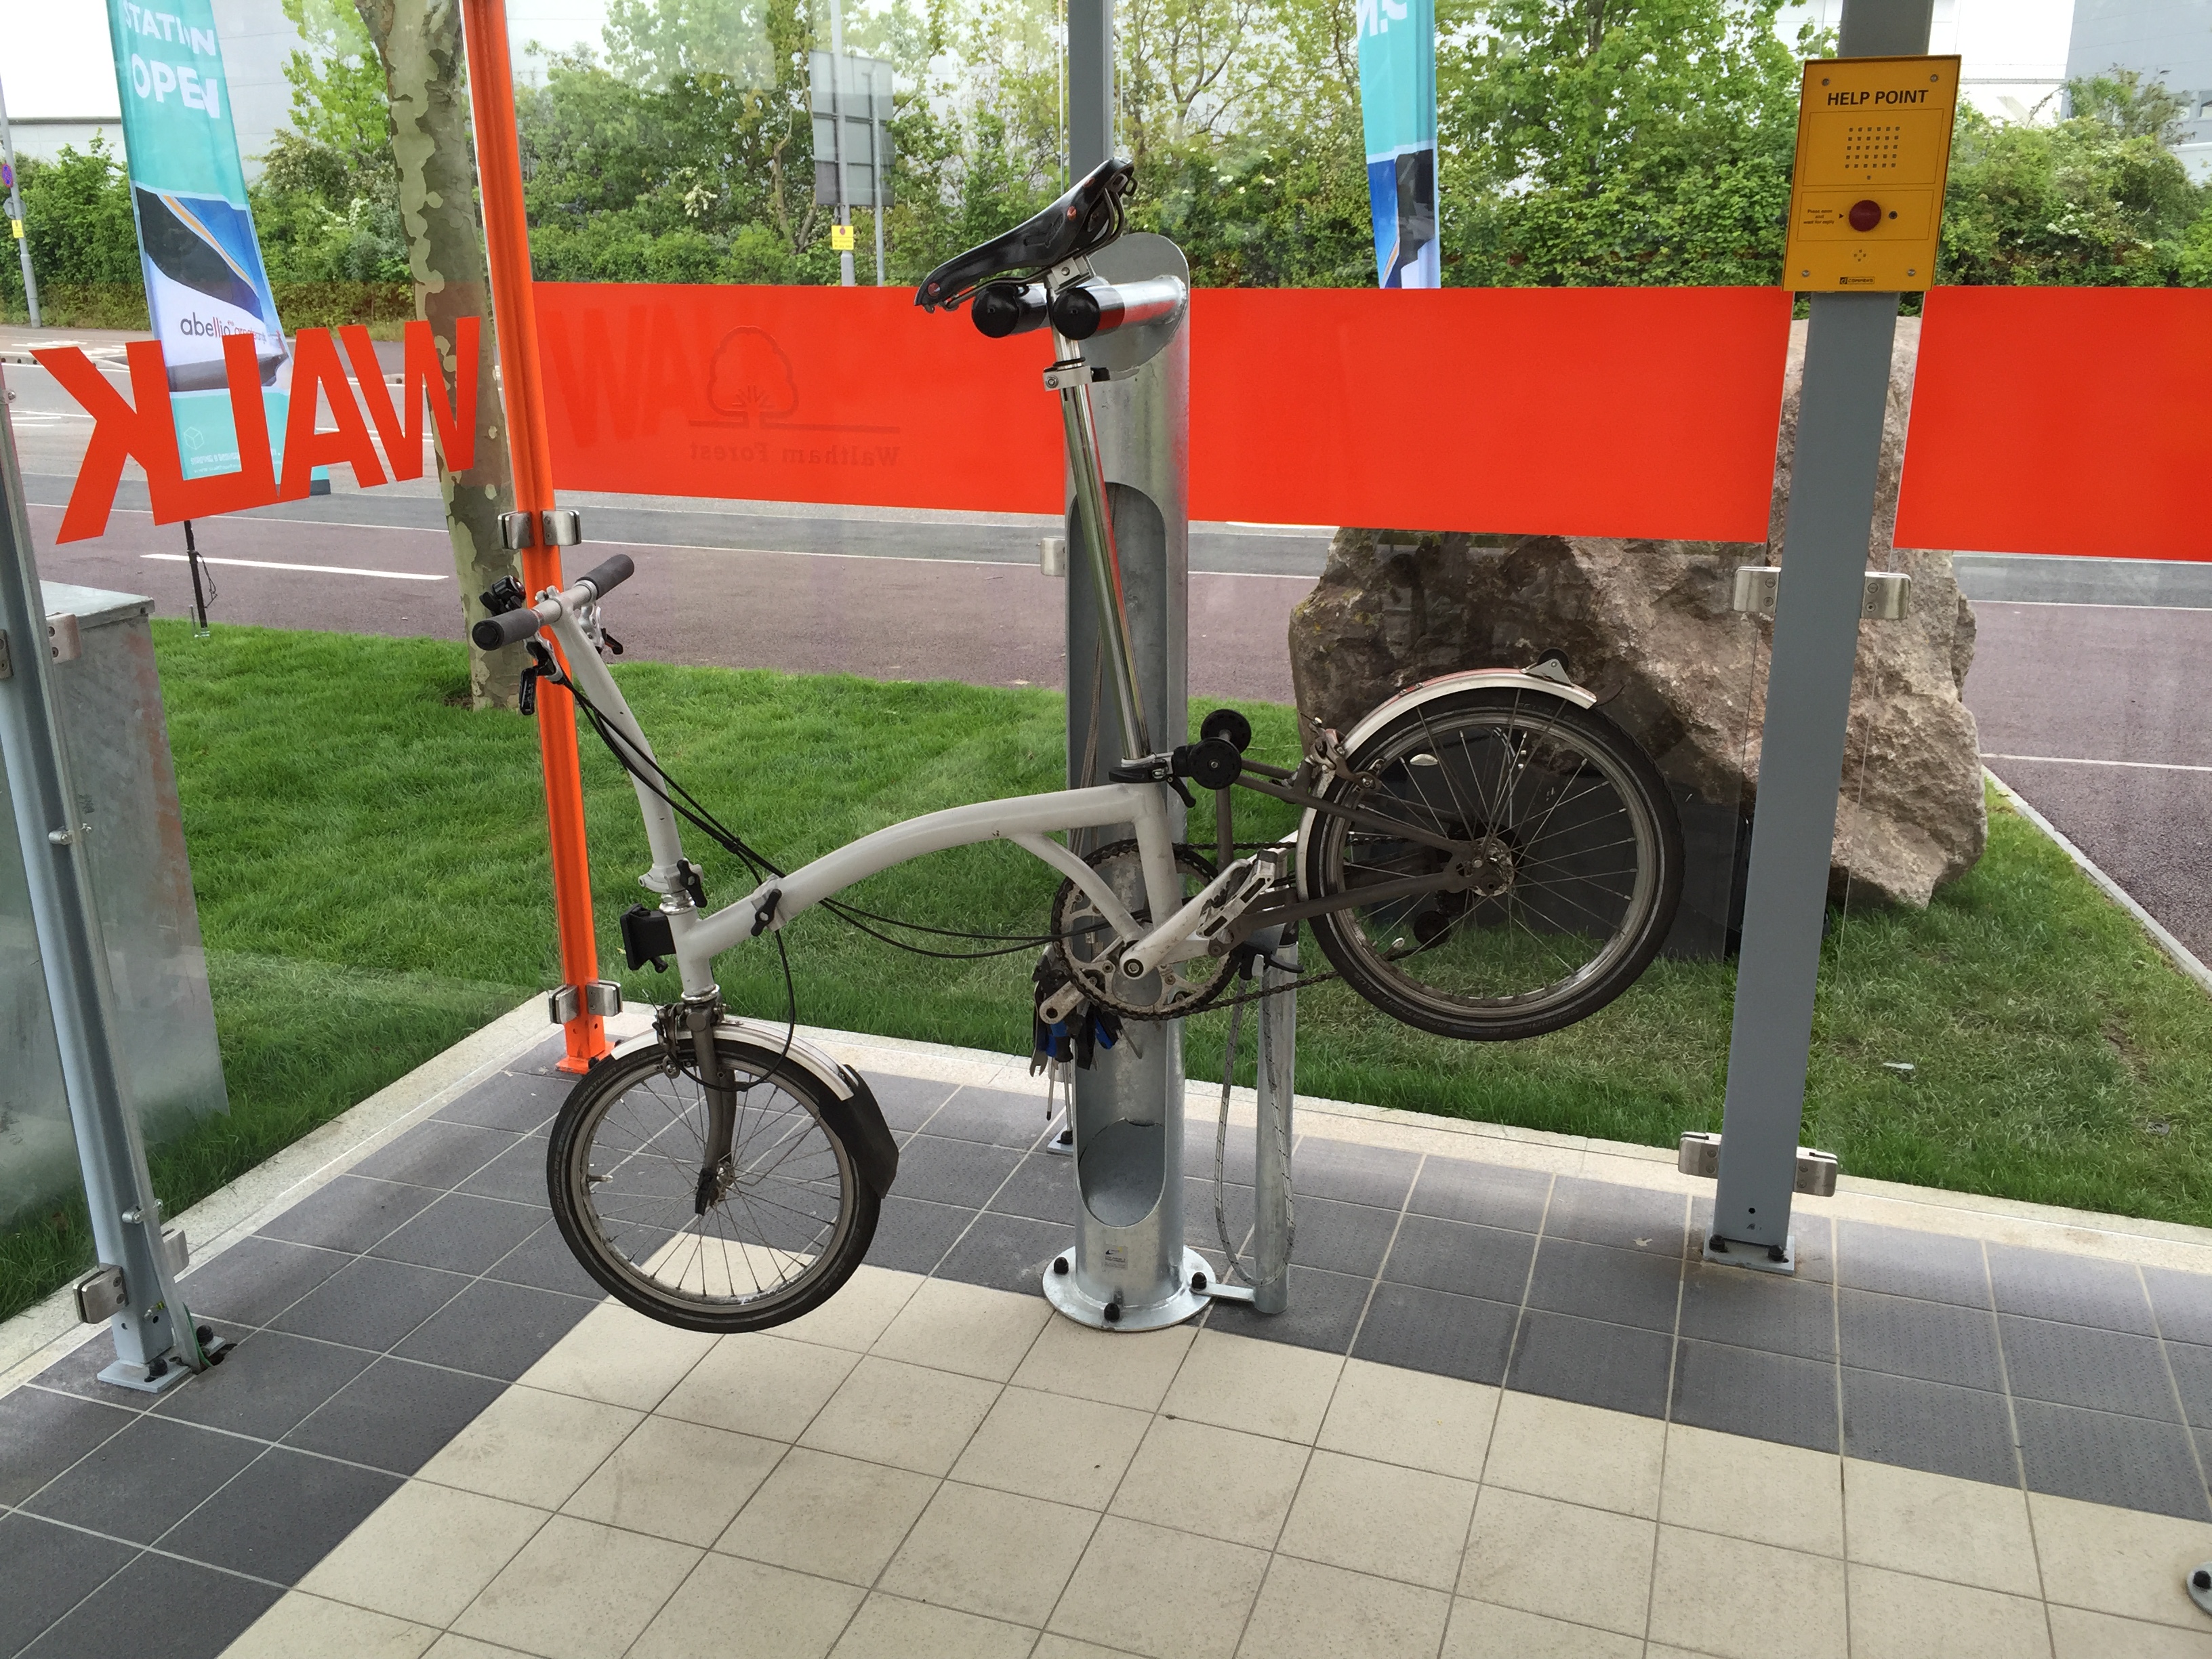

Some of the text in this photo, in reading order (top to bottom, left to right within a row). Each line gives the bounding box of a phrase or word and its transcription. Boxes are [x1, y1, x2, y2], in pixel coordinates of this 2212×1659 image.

[123, 1, 216, 56] STATIN
[131, 53, 220, 119] OPEN
[1827, 89, 1929, 106] HELP POINT
